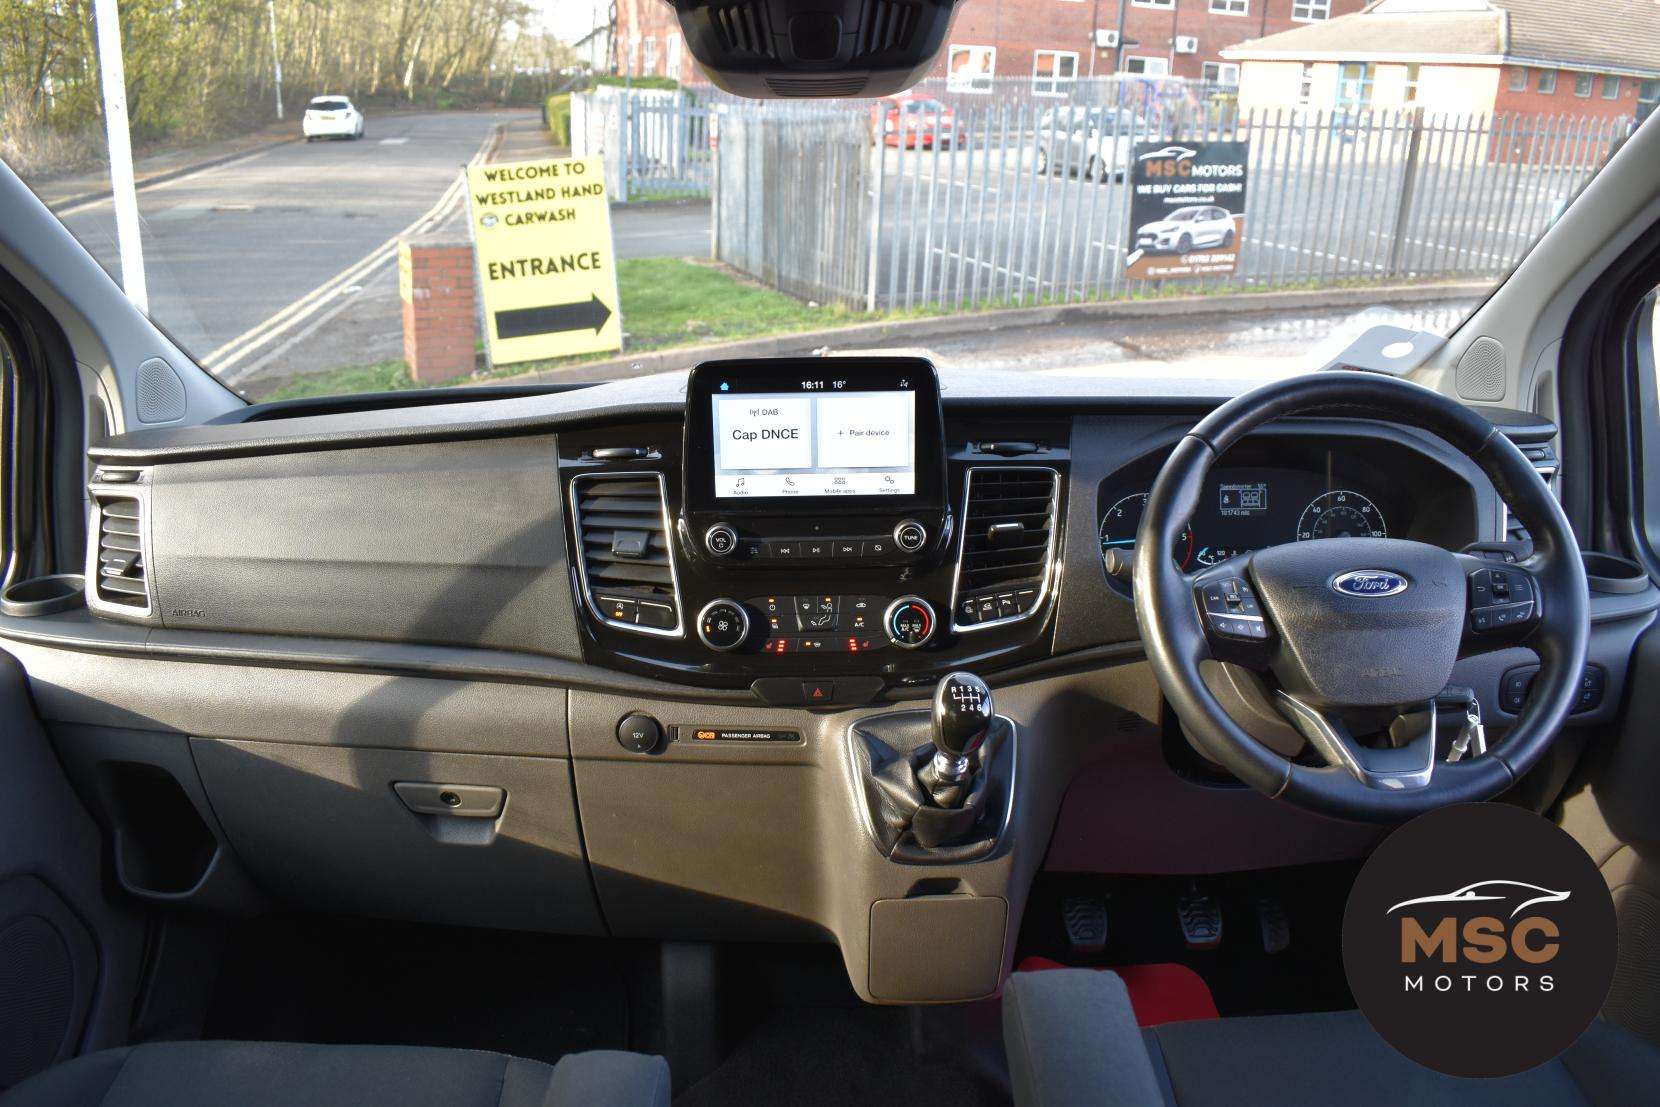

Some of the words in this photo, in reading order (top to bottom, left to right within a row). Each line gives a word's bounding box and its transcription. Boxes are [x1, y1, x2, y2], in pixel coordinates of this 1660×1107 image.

[485, 164, 559, 182] WELCOME
[564, 162, 585, 176] TO
[1145, 160, 1192, 178] MSC
[1191, 164, 1243, 177] MOTORS
[1136, 184, 1152, 194] WE
[1152, 184, 1172, 194] BUY
[1172, 183, 1196, 194] CARS
[1197, 183, 1215, 193] FOR
[475, 188, 556, 206] WESTLAND
[561, 183, 604, 199] HAND
[505, 208, 576, 226] CARWASH
[488, 251, 601, 280] ENTRANCE
[801, 381, 824, 389] 16:11
[832, 380, 846, 389] 16°
[761, 408, 779, 416] DAB
[732, 429, 758, 442] Cap
[761, 428, 799, 440] DNCE
[849, 429, 864, 437] Pair
[865, 429, 890, 437] device
[824, 487, 841, 495] Mobile
[879, 487, 901, 495] Settings
[1117, 508, 1123, 517] 2
[1181, 532, 1187, 540] 5
[1352, 575, 1390, 591] Ford
[172, 608, 206, 618] AIRBAG
[975, 685, 980, 693] 5
[961, 704, 966, 712] 2
[969, 704, 974, 712] 4
[977, 704, 982, 712] 6
